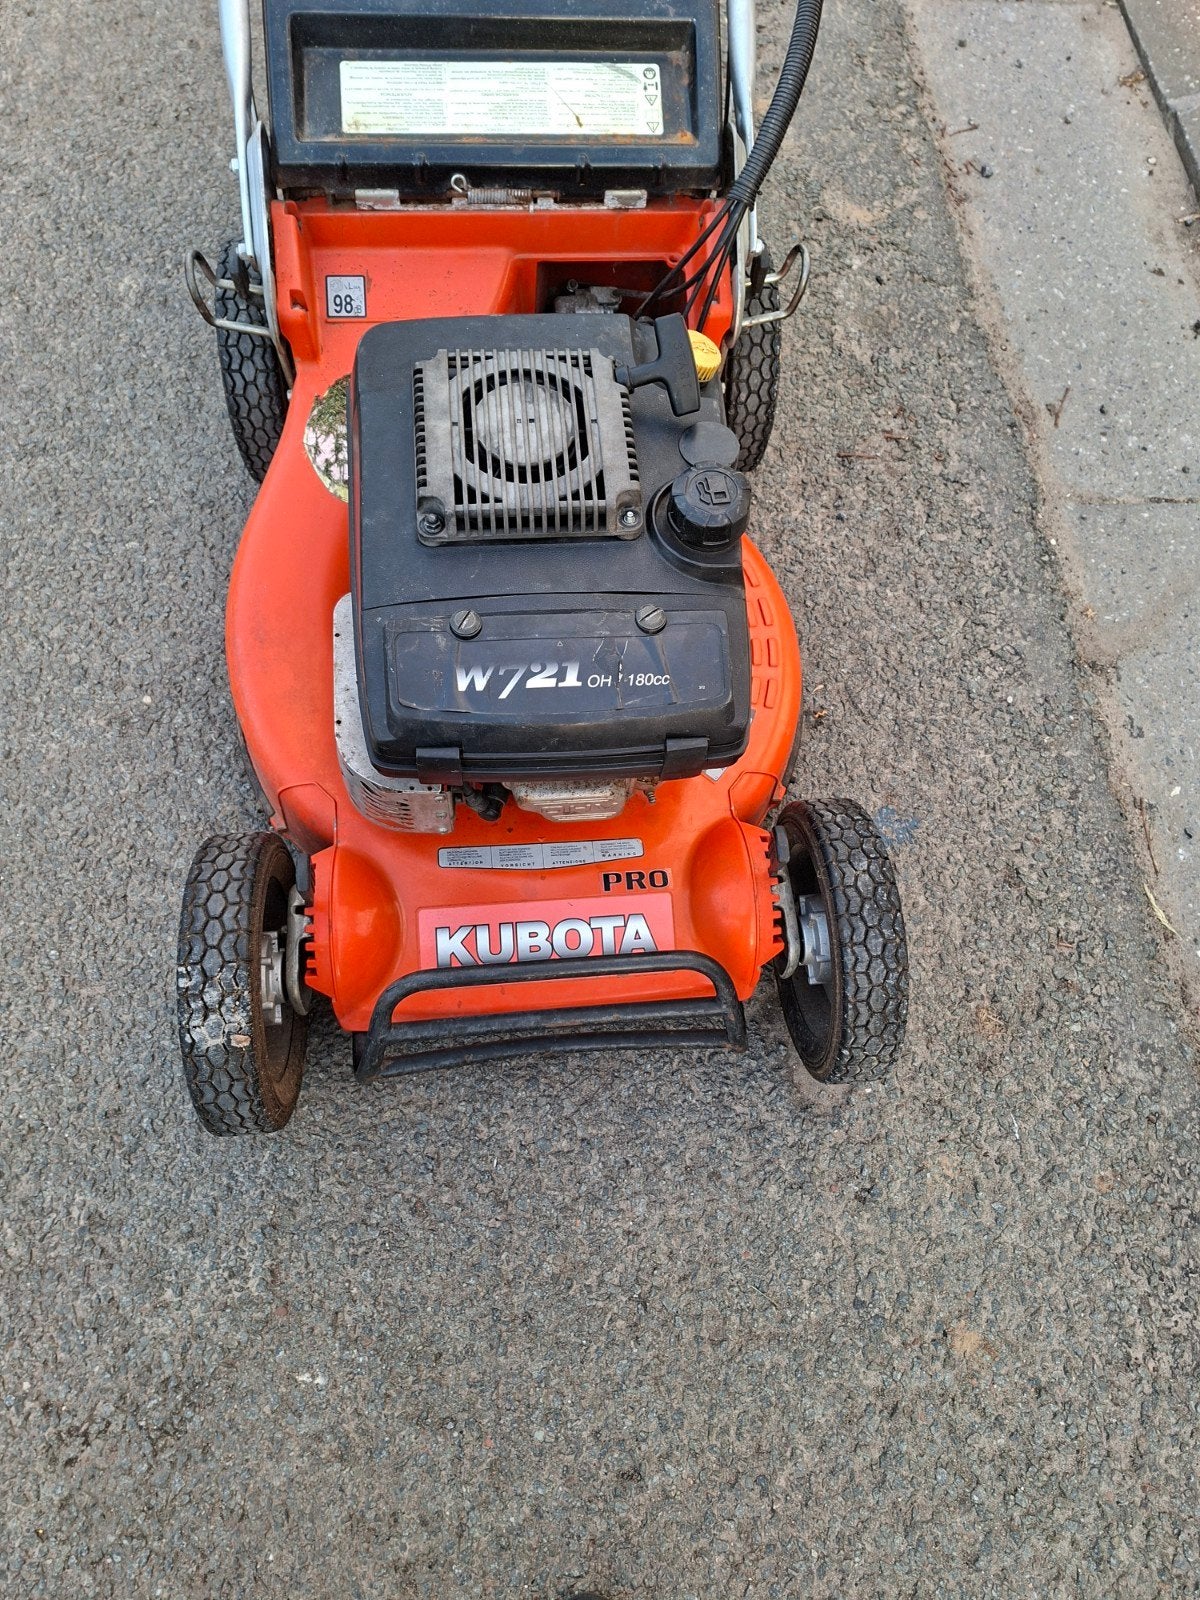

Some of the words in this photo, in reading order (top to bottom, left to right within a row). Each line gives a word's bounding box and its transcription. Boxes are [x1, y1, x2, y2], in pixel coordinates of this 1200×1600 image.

[333, 294, 353, 314] 98
[628, 673, 670, 687] 180cc
[602, 870, 669, 892] PRO
[435, 913, 659, 968] KUBOTA
